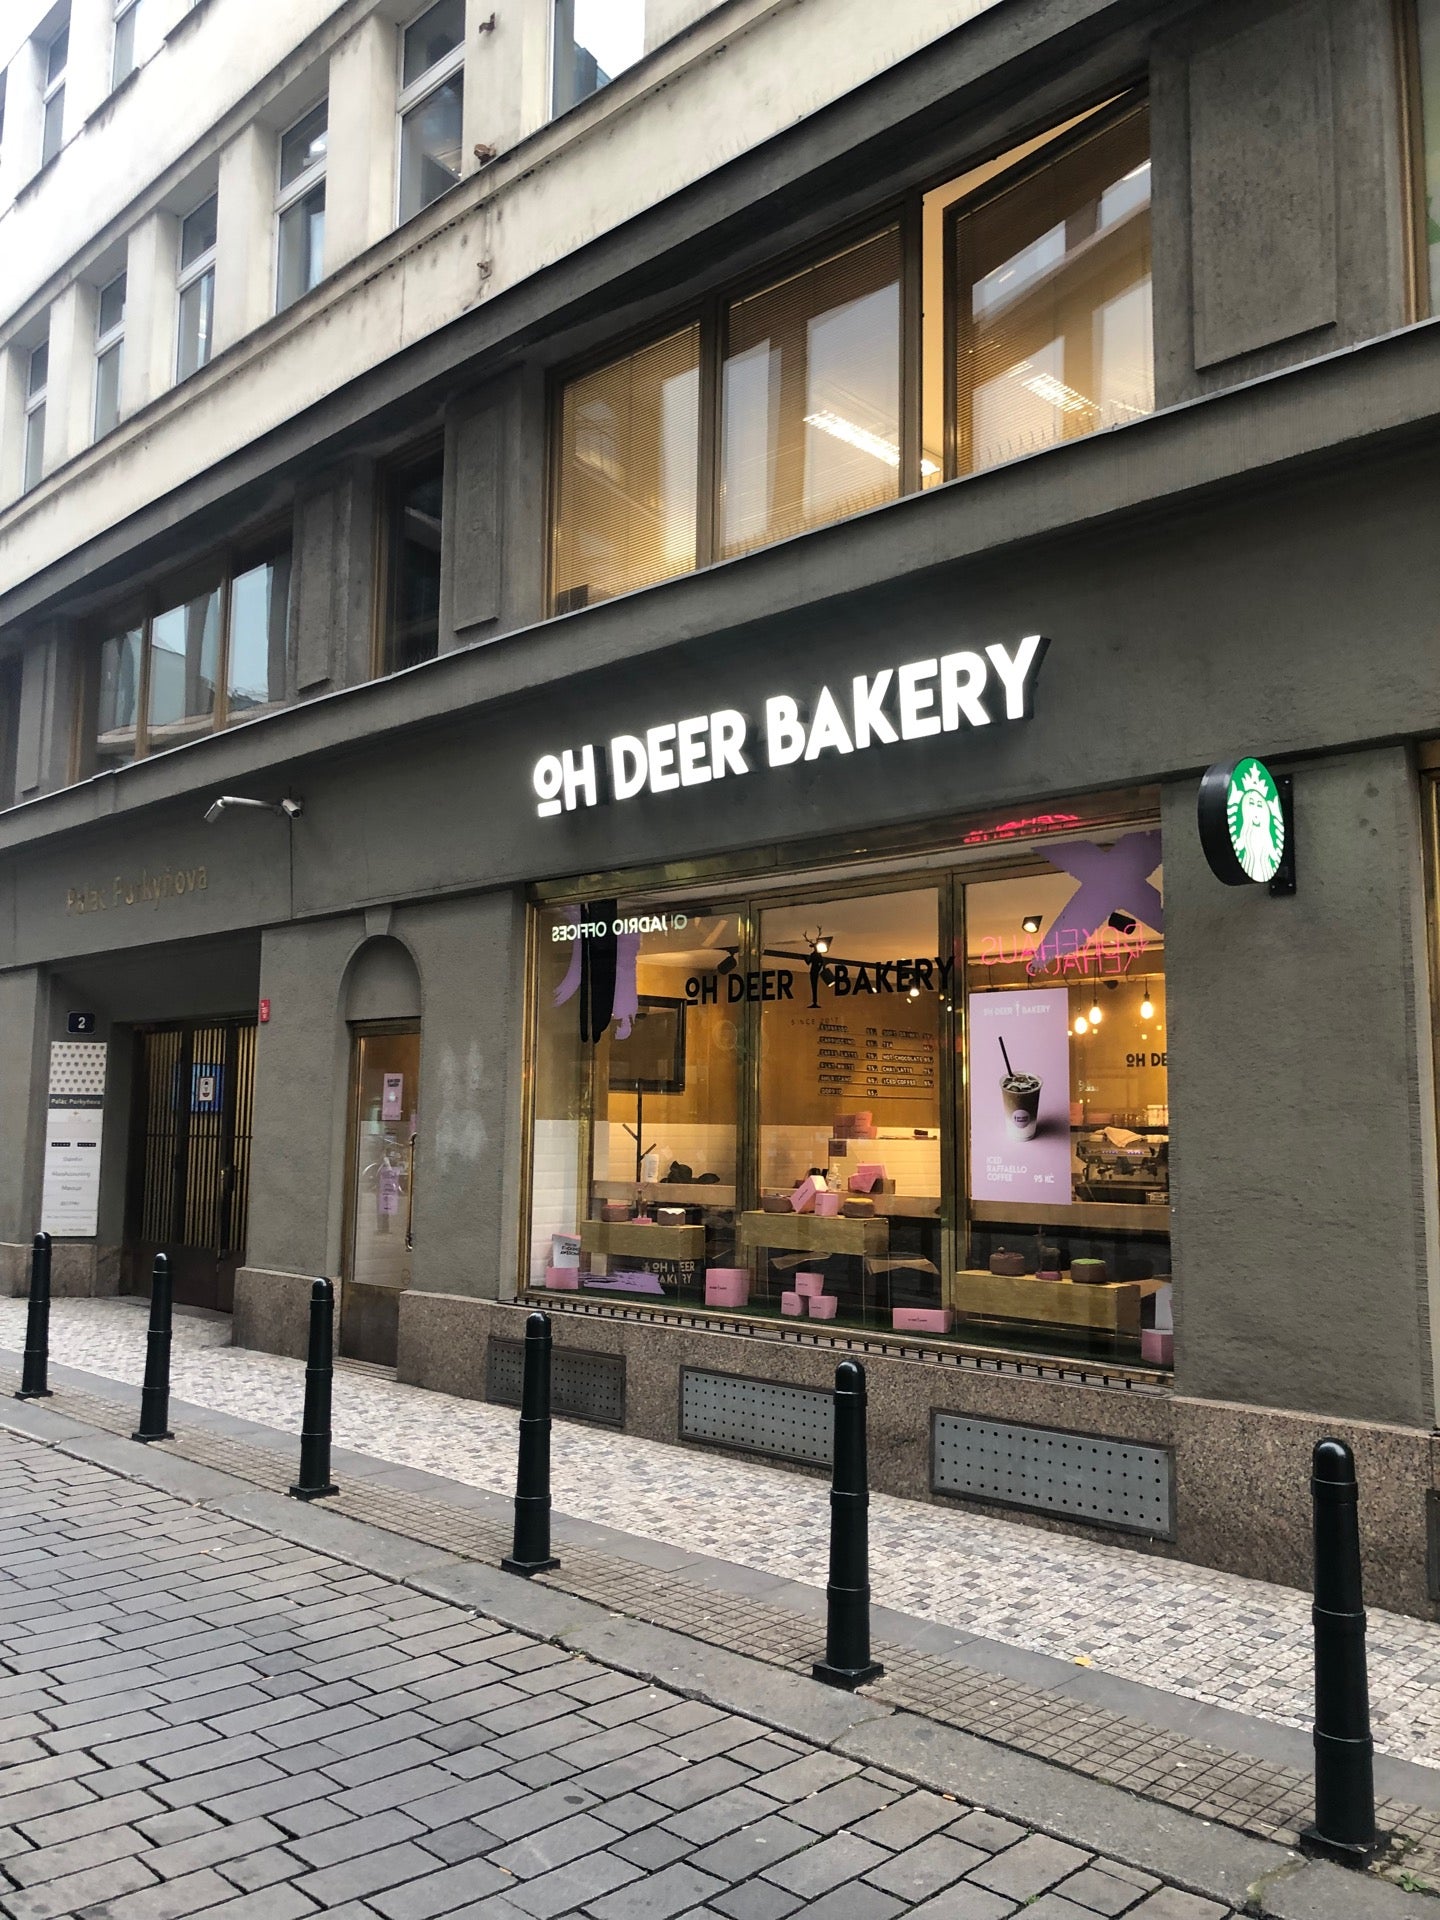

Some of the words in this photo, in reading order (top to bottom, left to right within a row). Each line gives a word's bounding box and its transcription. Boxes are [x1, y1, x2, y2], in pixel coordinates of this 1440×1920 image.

[533, 744, 597, 818] OH
[611, 709, 749, 800] DEER
[766, 635, 1042, 767] BAKERY
[685, 975, 718, 1006] OH
[728, 969, 794, 1003] DEER
[834, 957, 955, 997] BAKERY
[1022, 1004, 1051, 1015] BAKERY
[77, 1017, 86, 1029] 2
[894, 1054, 923, 1063] CHOCOLATE
[1126, 1053, 1146, 1068] OH
[986, 1173, 1013, 1182] COFFEE
[652, 1261, 668, 1273] OH
